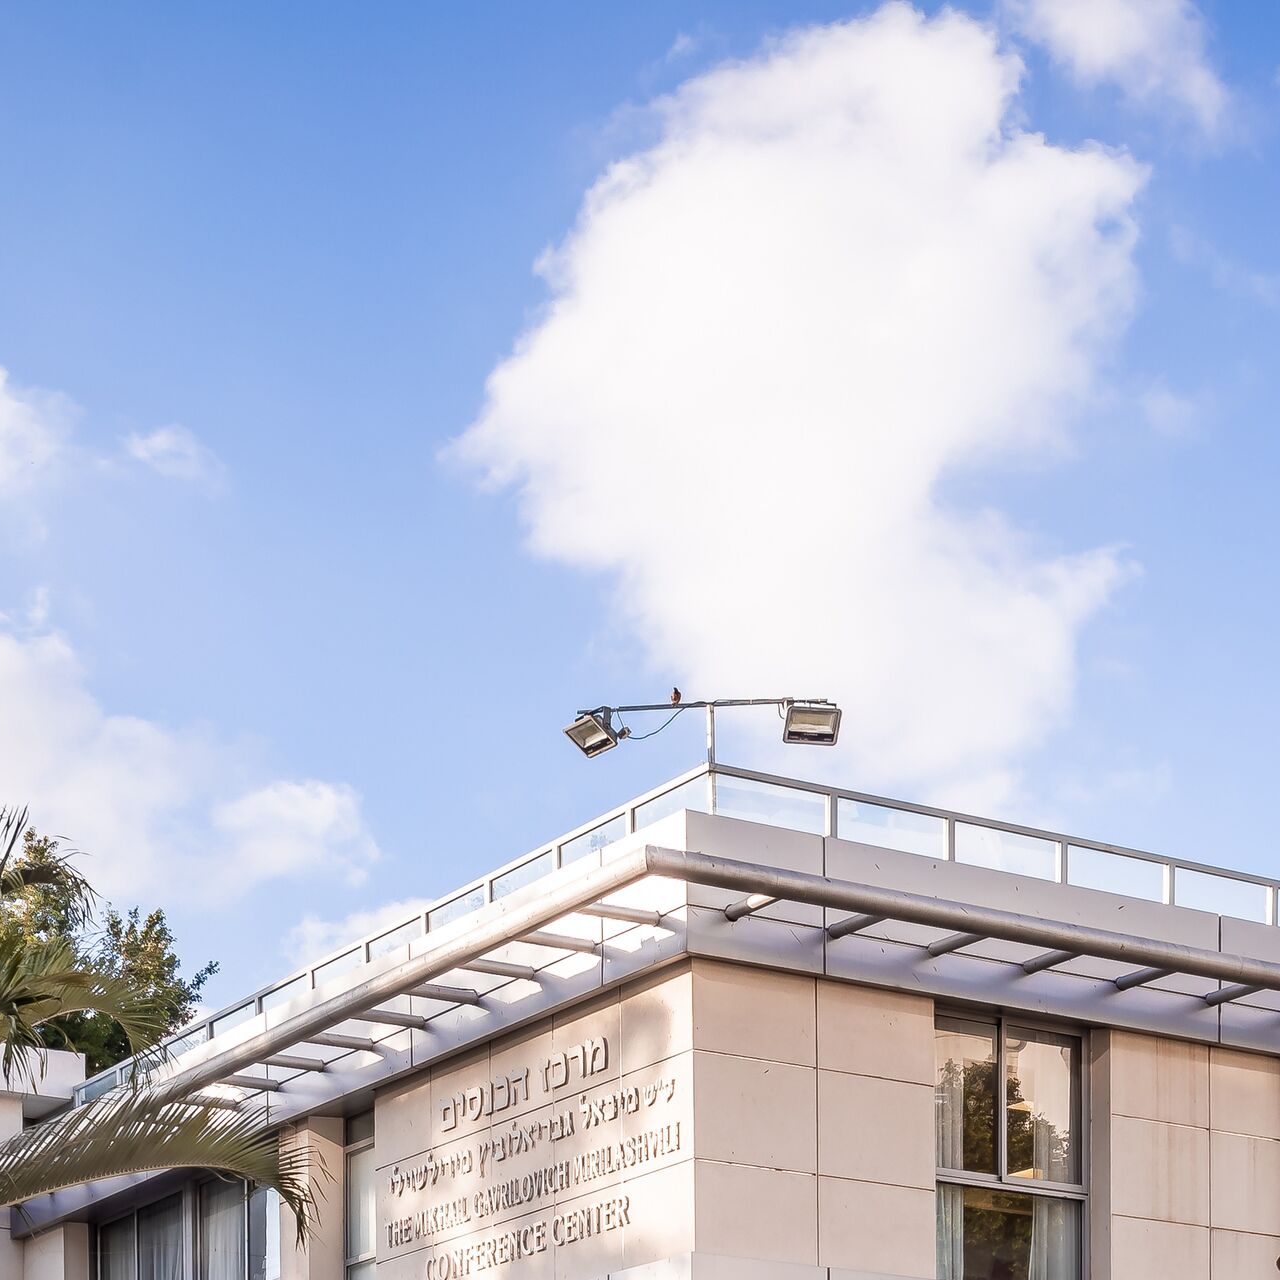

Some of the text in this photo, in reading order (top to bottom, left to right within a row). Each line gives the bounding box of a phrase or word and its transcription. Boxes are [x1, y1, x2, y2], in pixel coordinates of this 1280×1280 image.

[439, 1036, 609, 1132] מרכז הכנסים
[578, 1085, 640, 1130] מיכאל
[384, 1121, 681, 1249] THE MIKHAIL GAVRILOVICH MIRILASHVILI
[551, 1195, 631, 1247] CENTER
